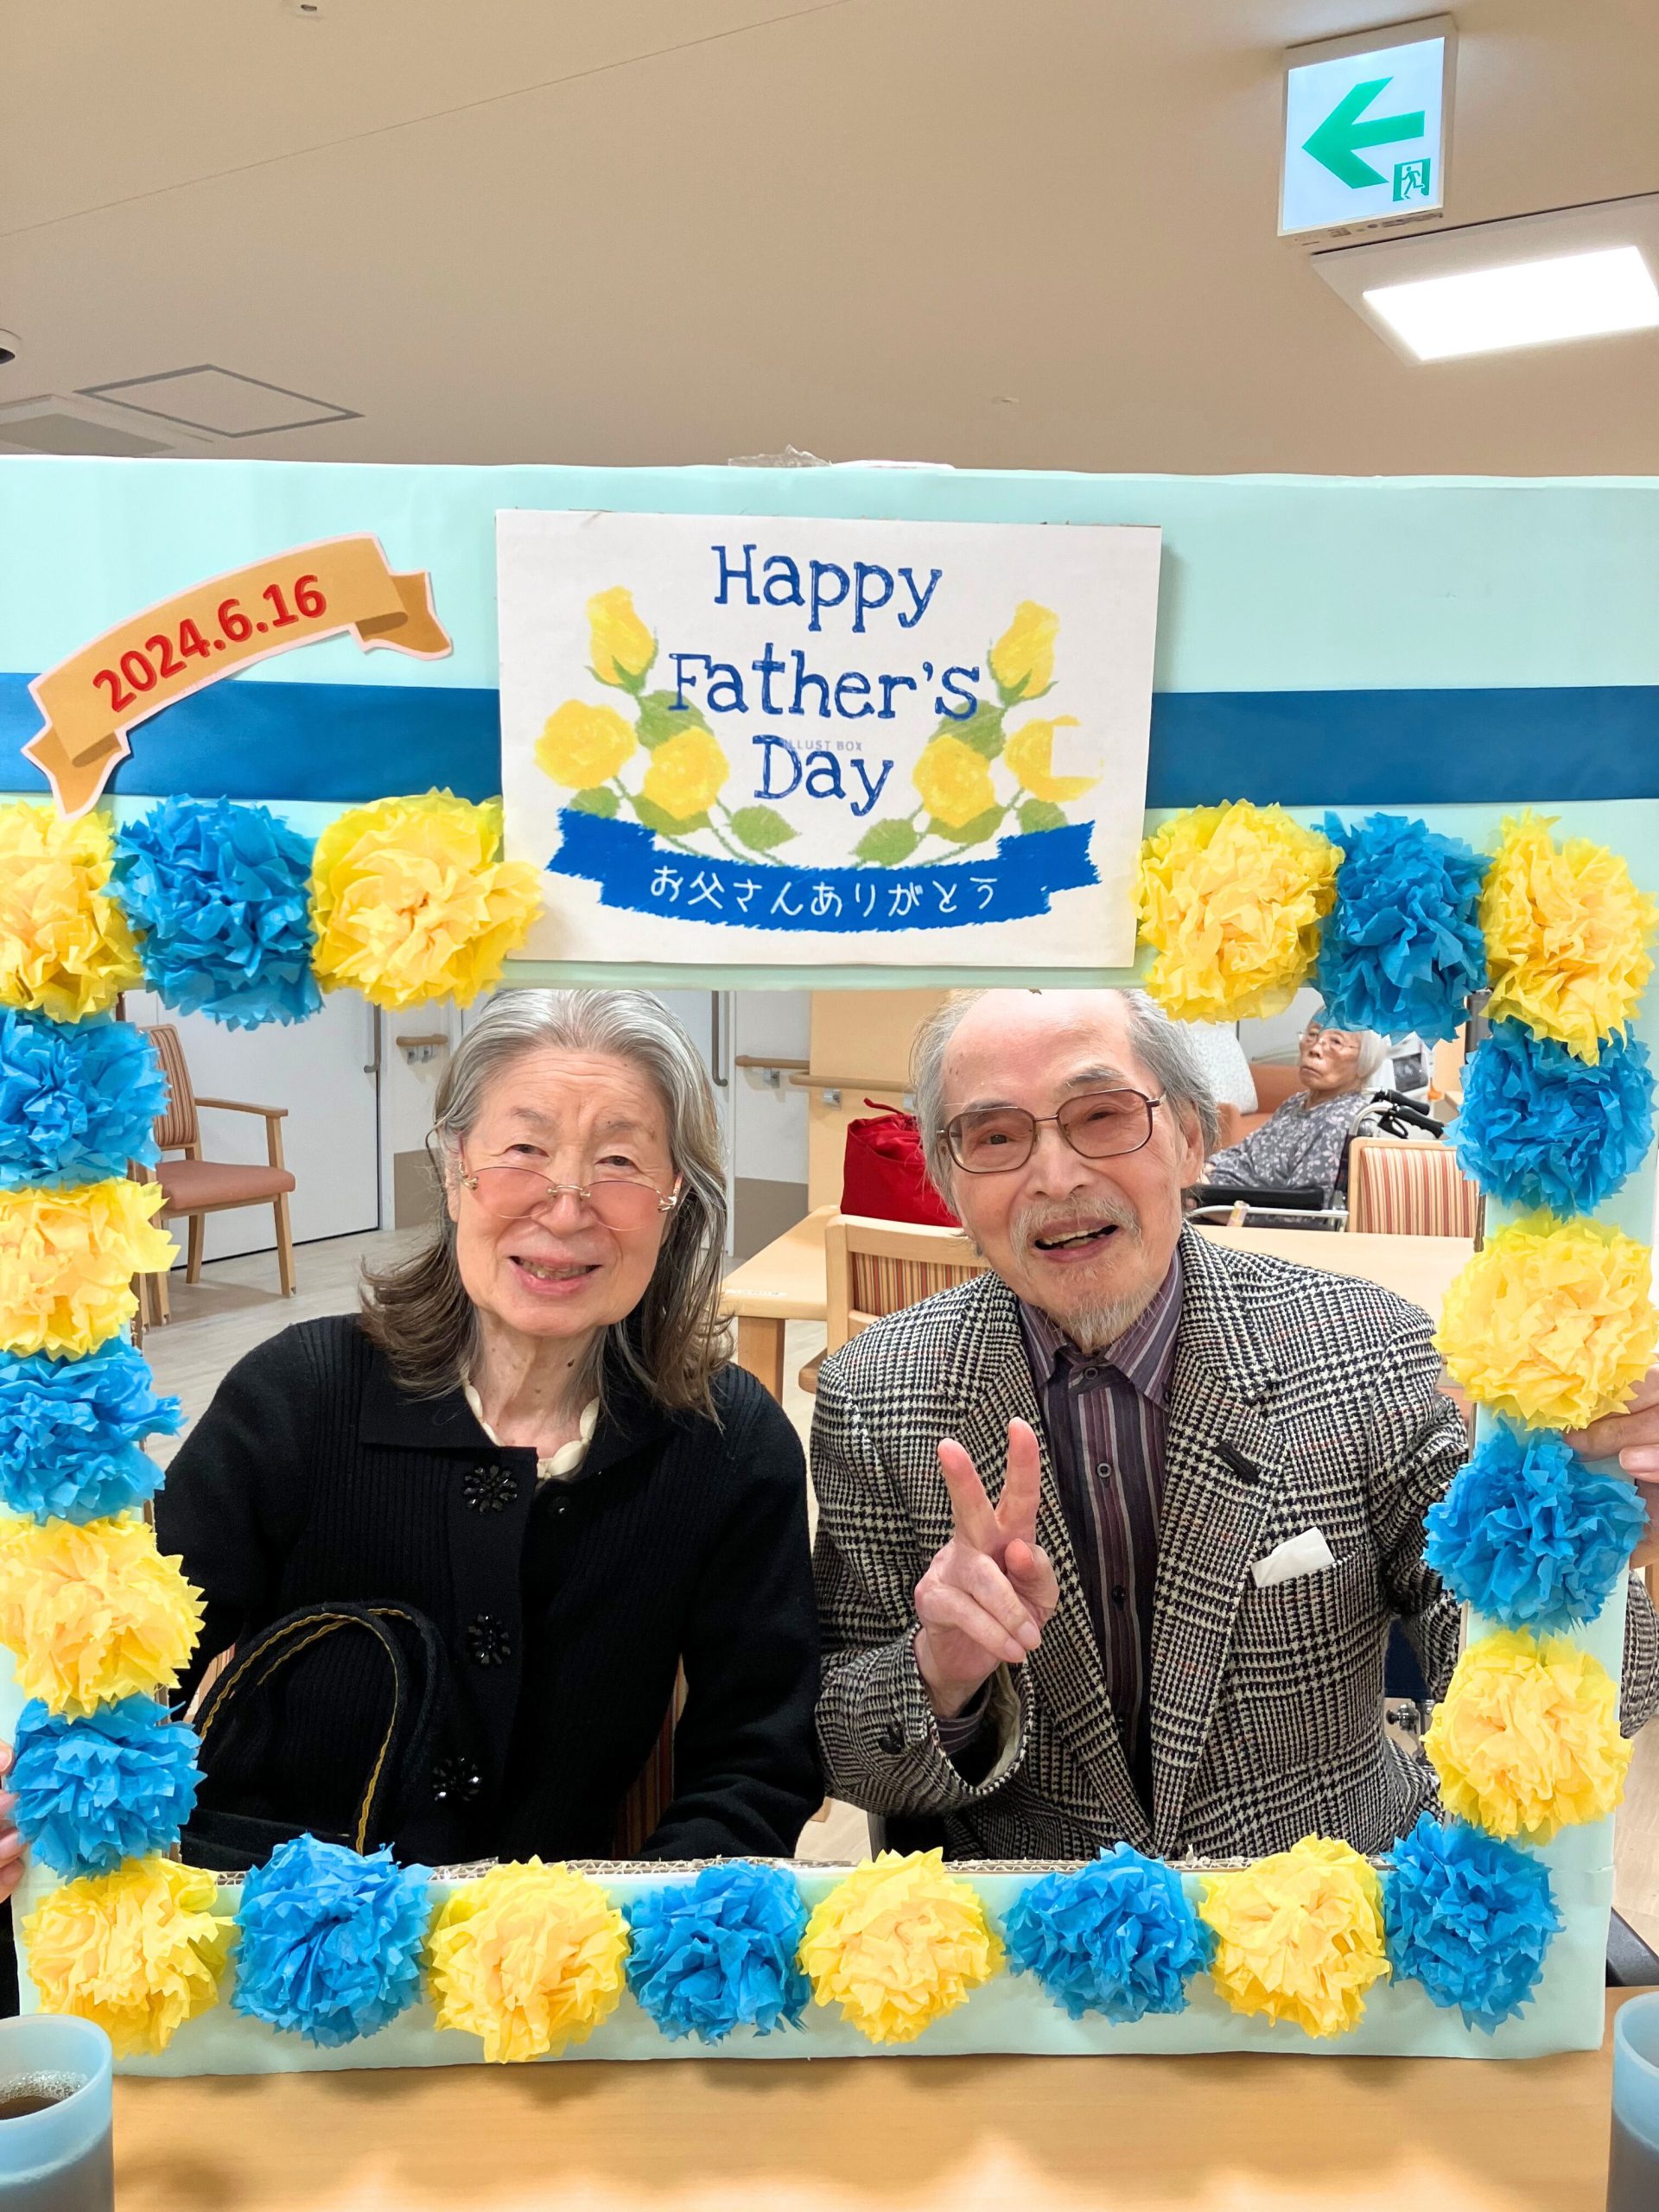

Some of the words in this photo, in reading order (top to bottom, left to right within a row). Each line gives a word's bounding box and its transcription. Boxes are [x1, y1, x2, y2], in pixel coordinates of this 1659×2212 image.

[710, 544, 942, 633] Happy
[92, 575, 327, 712] 2024.6.16
[668, 642, 980, 721] Father's
[752, 734, 894, 817] Day
[836, 741, 862, 752] BOX
[650, 865, 998, 918] お父さんありがとう
